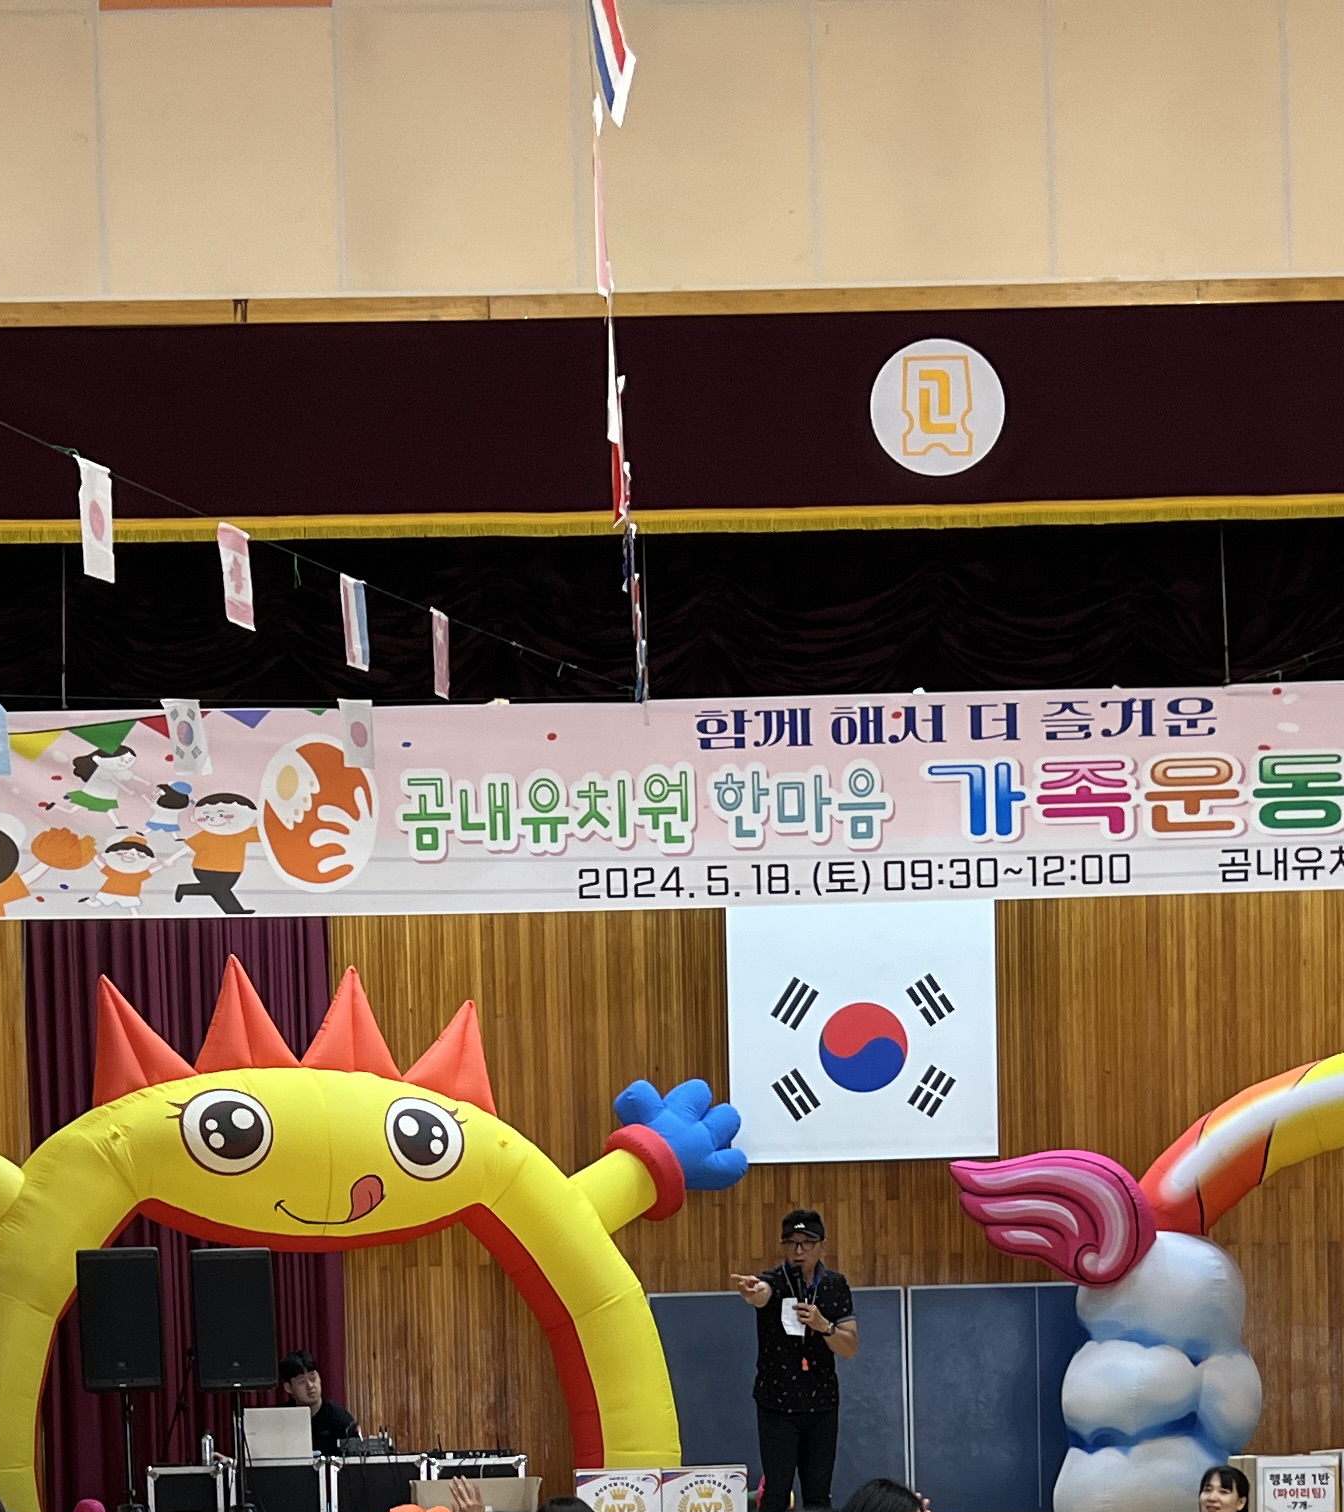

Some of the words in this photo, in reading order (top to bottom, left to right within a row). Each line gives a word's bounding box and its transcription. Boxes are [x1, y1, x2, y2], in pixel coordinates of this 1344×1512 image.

[694, 706, 813, 750] 함께
[830, 703, 946, 749] 해서
[967, 701, 1022, 742] 더
[1040, 697, 1218, 742] 즐거운
[401, 769, 690, 852] 곰내유치원
[713, 766, 888, 841] 한마음
[1269, 1473, 1307, 1486] 행복샘
[1311, 1473, 1330, 1486] 1반
